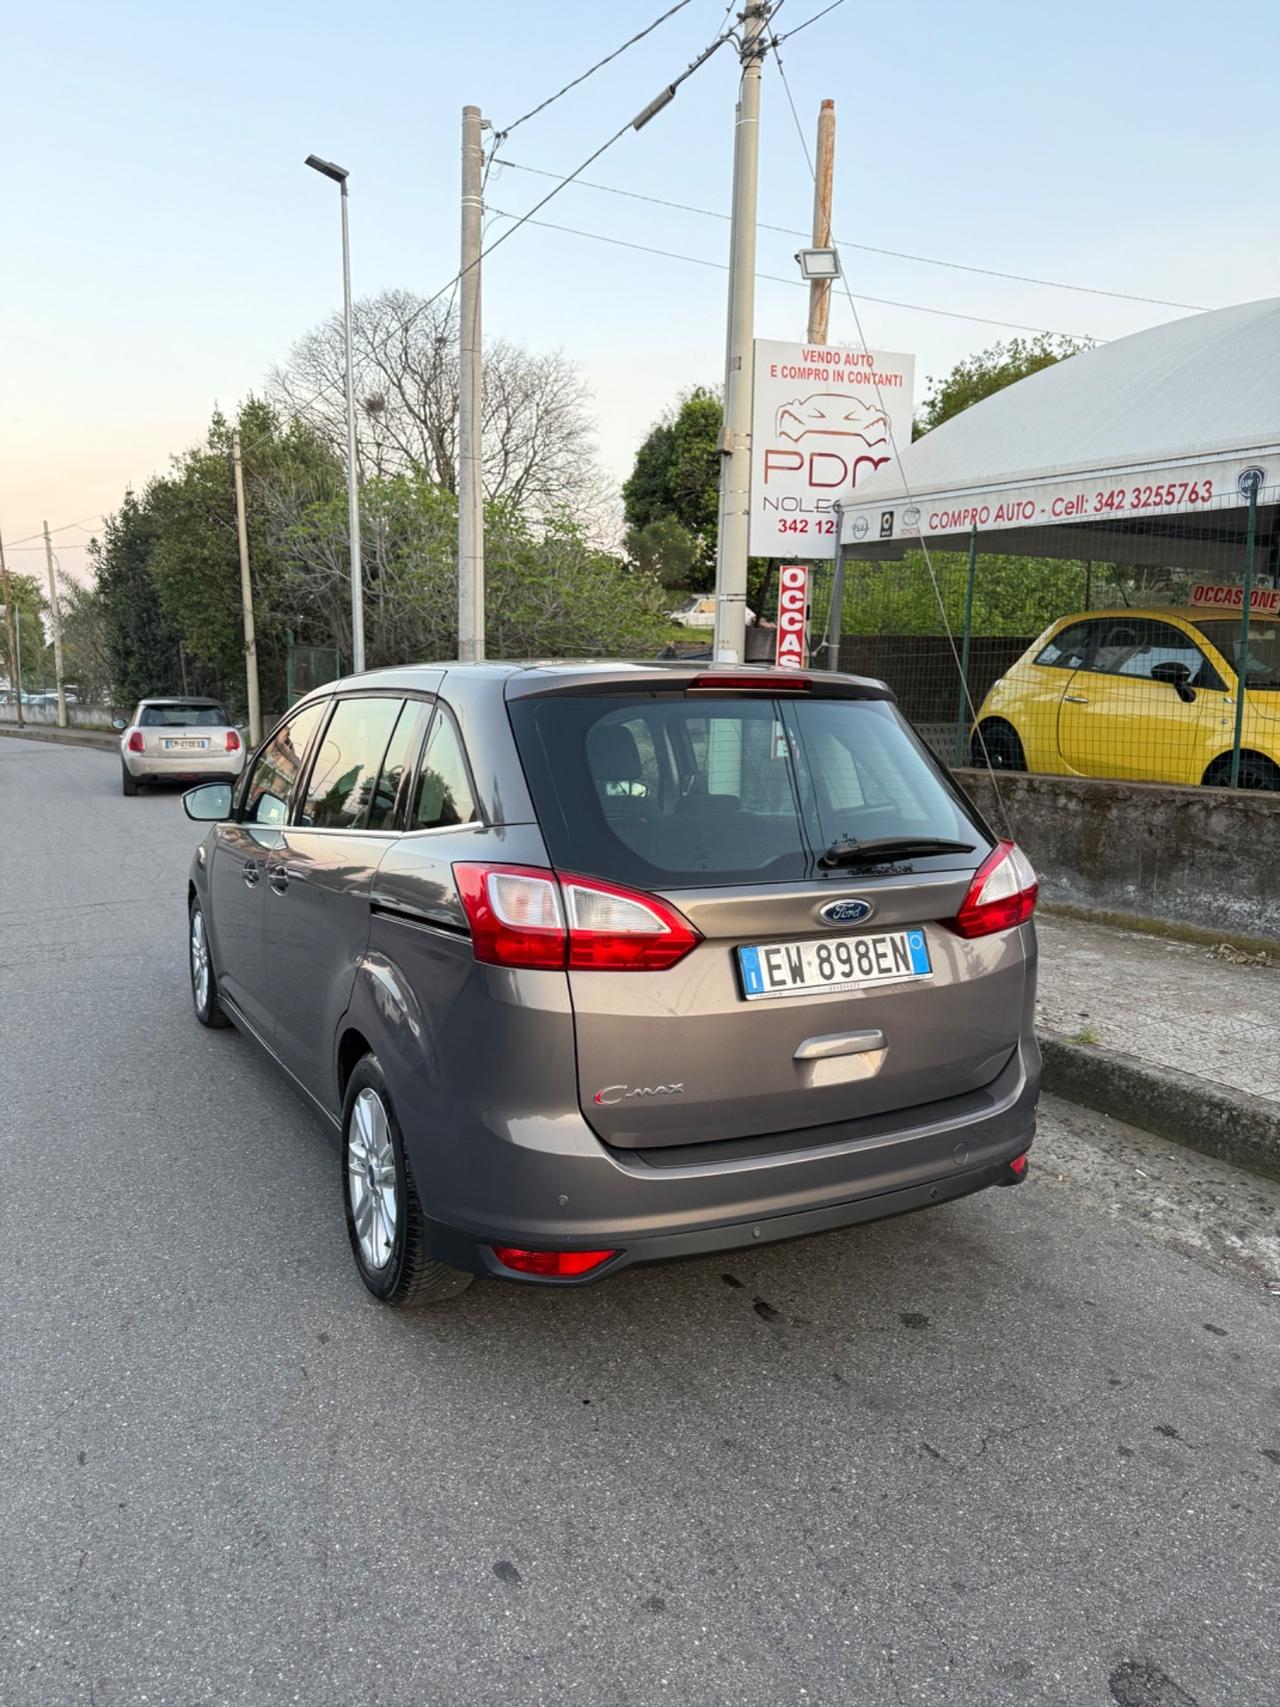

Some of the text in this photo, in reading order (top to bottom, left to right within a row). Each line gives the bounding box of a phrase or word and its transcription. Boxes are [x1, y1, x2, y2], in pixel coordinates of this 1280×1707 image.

[801, 349, 874, 367] VENDO AUTO
[770, 364, 904, 388] E COMPRO IN CONTANTI
[929, 504, 991, 530] COMPRO
[994, 500, 1036, 523] AUTO
[1051, 494, 1090, 518] Cell:
[1093, 489, 1126, 513] 342
[1130, 480, 1213, 509] 3255763
[778, 518, 809, 533] 342
[1193, 585, 1280, 609] OCCASONE
[832, 903, 862, 919] Ford
